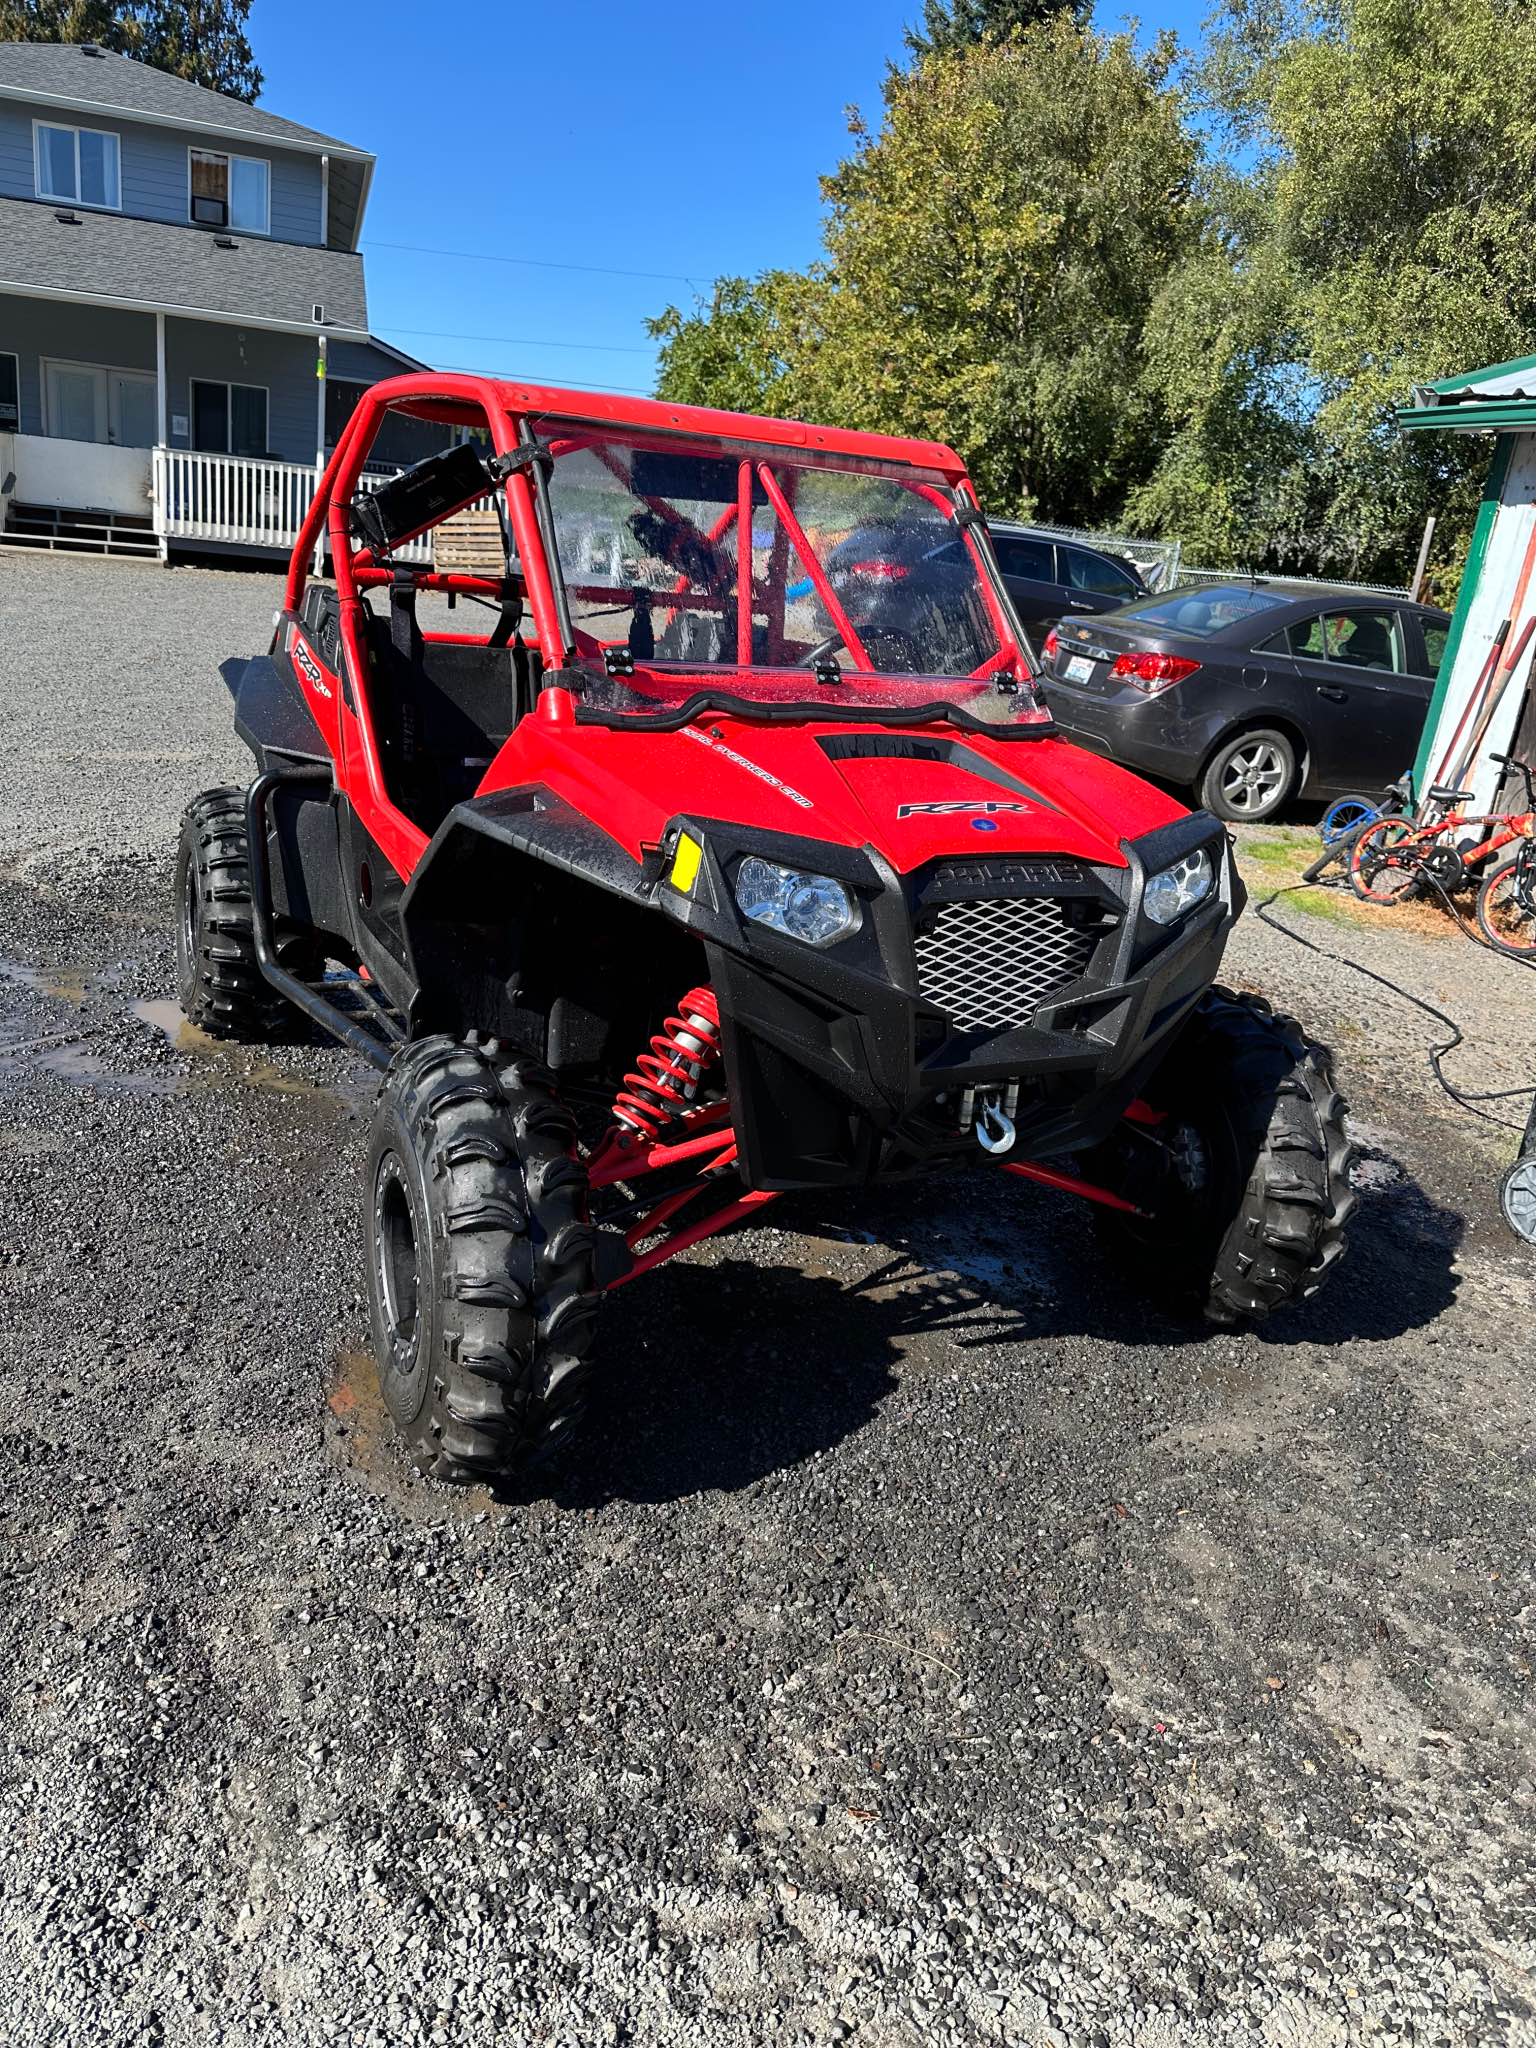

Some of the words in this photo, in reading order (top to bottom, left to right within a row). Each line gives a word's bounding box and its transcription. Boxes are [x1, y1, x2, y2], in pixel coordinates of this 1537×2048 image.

[292, 638, 322, 692] RZR
[713, 744, 783, 787] OVERHEAD
[779, 785, 814, 808] CAM
[897, 802, 1034, 819] RZR
[934, 862, 1084, 887] POLARIS
